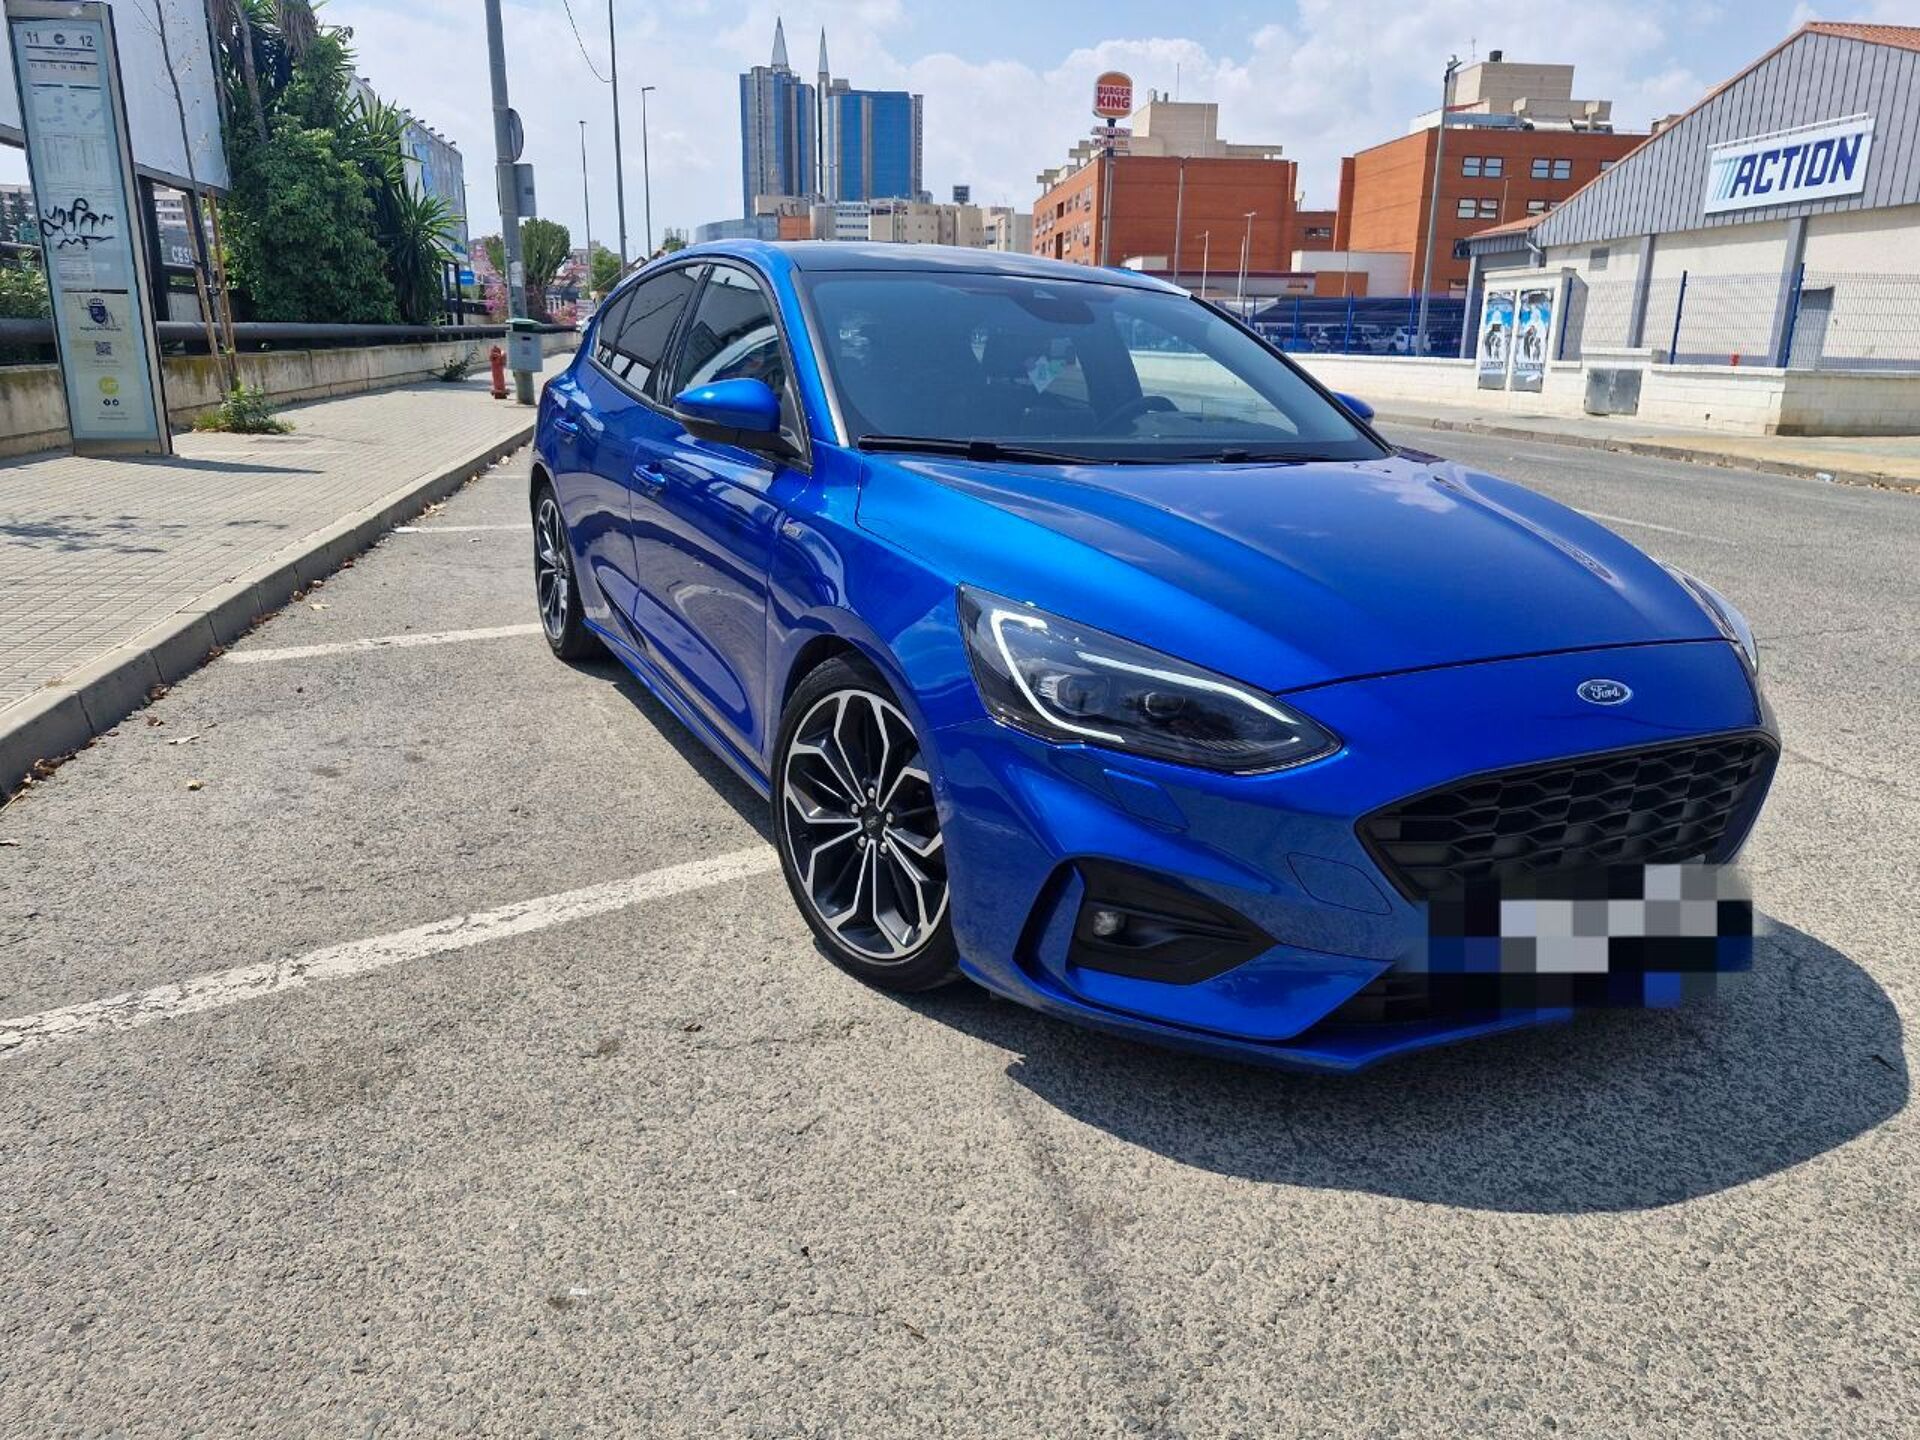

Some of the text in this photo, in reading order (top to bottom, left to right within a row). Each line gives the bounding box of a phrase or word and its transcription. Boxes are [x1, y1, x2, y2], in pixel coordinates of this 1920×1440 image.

[26, 31, 93, 47] 11 12
[1097, 86, 1130, 96] BURGER
[1097, 95, 1130, 108] KING
[1729, 133, 1863, 198] ACTION
[1590, 684, 1621, 699] Ford
